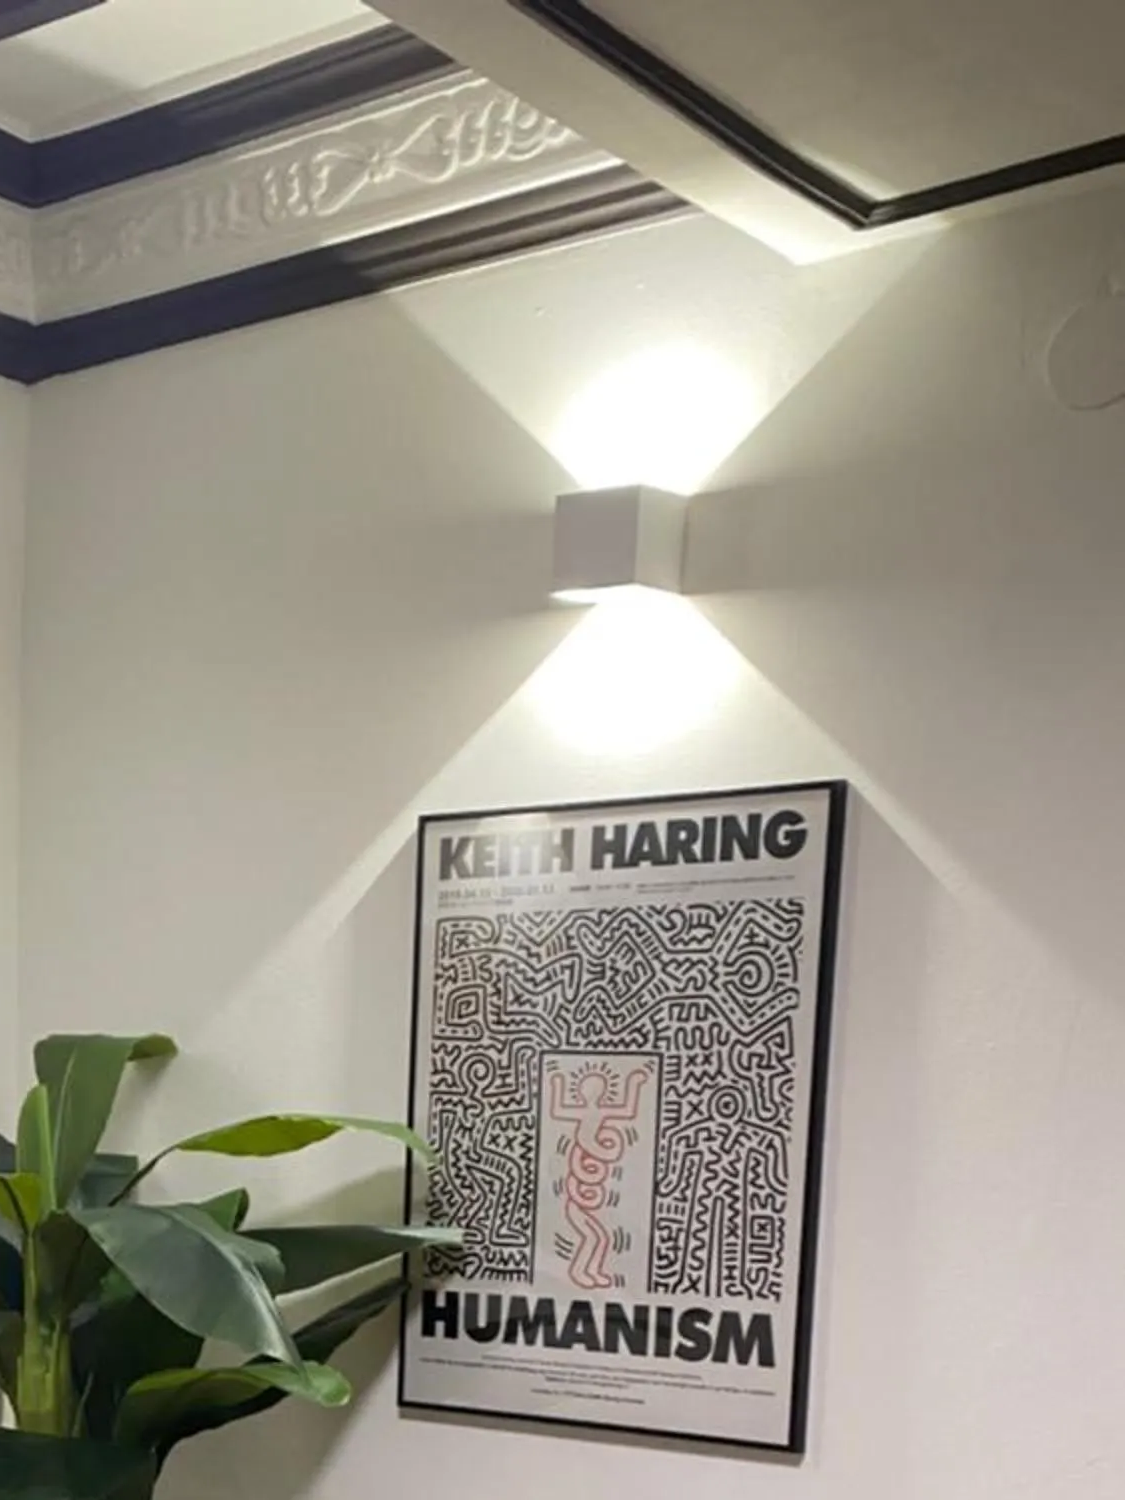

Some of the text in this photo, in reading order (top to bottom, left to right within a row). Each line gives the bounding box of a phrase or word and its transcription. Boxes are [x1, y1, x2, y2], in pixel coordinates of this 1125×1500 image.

[439, 810, 808, 881] KEITH HARING
[421, 1291, 777, 1368] HUMANISM
